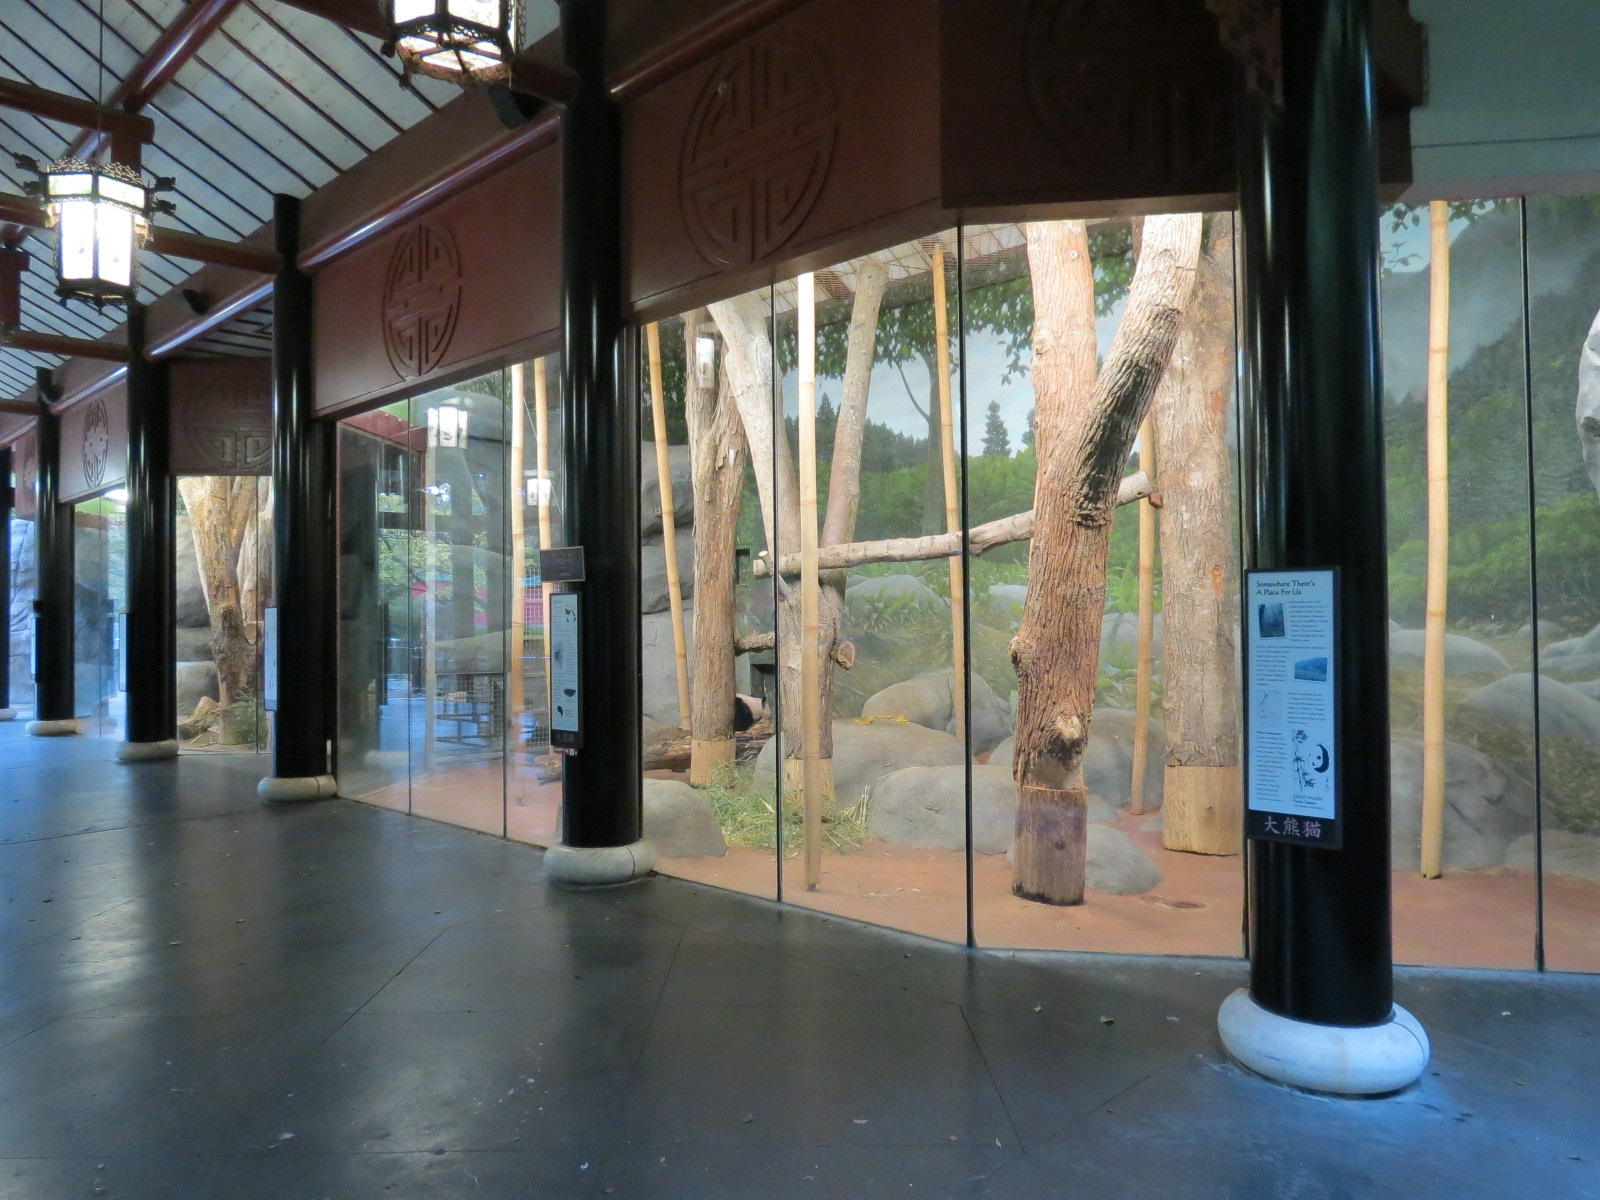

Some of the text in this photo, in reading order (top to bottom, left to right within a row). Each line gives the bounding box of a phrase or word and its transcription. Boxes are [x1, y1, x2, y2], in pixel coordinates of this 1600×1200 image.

[1256, 580, 1290, 588] Somewhere
[1281, 588, 1291, 596] For
[1264, 816, 1321, 838] 大熊猫
